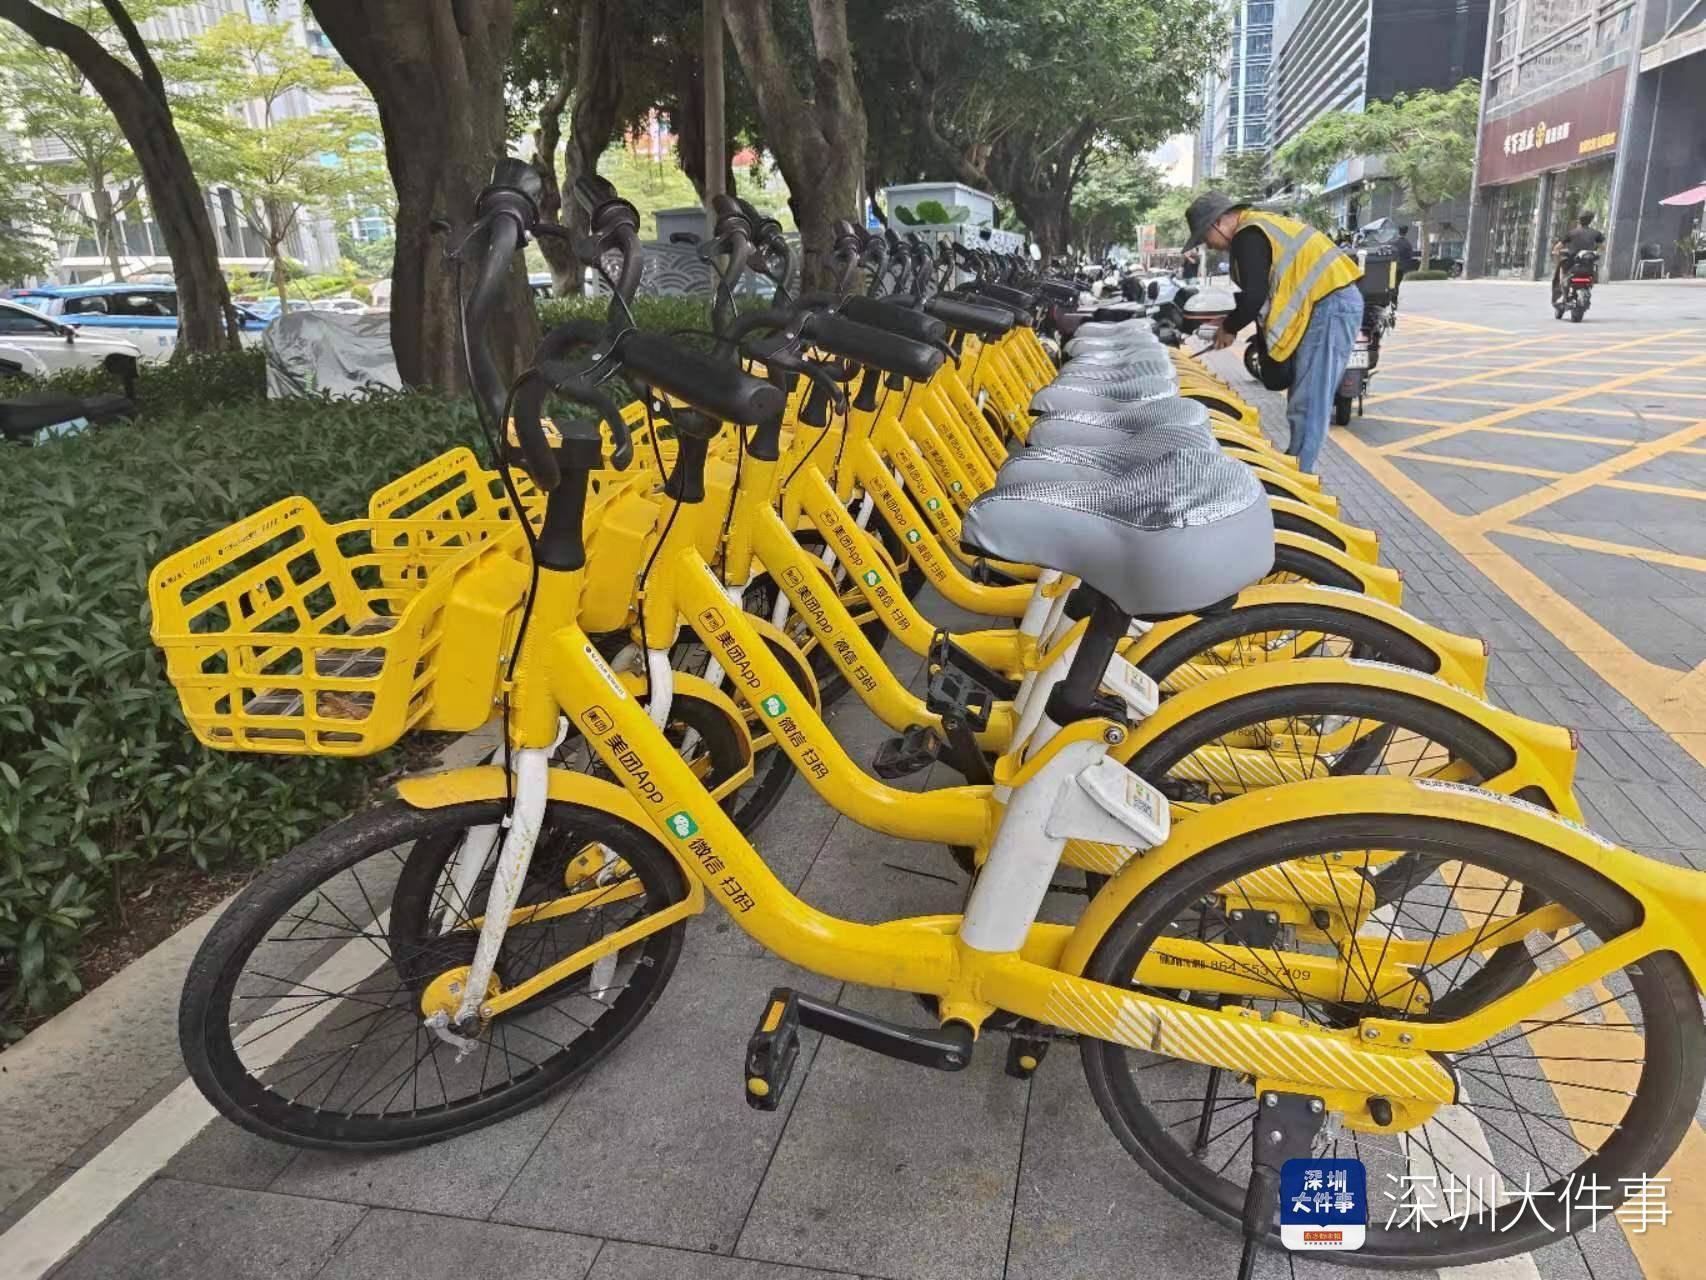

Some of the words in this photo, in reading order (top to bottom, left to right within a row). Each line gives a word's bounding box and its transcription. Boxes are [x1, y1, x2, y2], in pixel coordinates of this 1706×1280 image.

[797, 585, 832, 634] 美团App
[833, 638, 857, 666] 微信
[854, 665, 877, 692] 扫码
[833, 525, 863, 566] 美团App
[890, 608, 911, 631] 扫码
[715, 630, 761, 690] 美团App
[777, 716, 807, 747] 微信
[800, 747, 829, 780] 扫码
[605, 733, 664, 805] 美团App
[688, 838, 725, 877] 微信
[719, 876, 756, 913] 扫码
